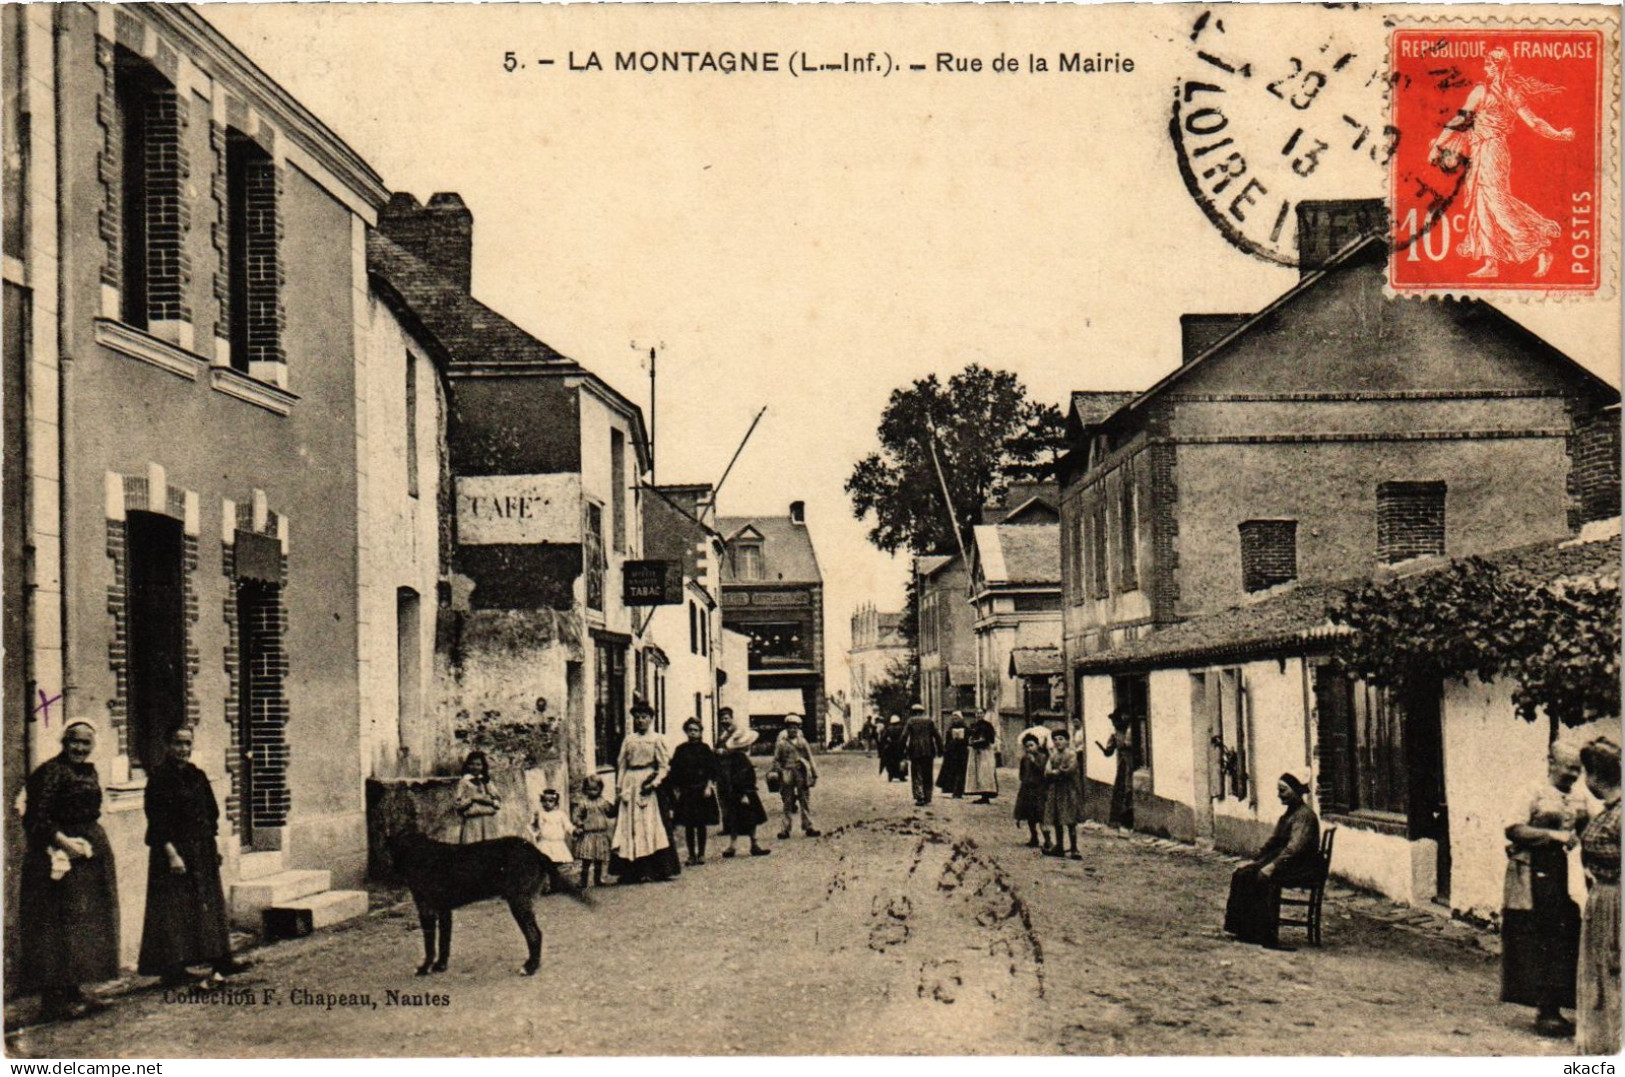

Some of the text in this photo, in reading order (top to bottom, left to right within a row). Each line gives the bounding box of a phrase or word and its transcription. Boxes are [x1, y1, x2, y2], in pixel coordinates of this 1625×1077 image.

[1512, 40, 1595, 60] FRANÇAISE
[1184, 80, 1269, 223] LOIRE
[1571, 190, 1592, 274] POSTES
[630, 585, 662, 597] TABAC
